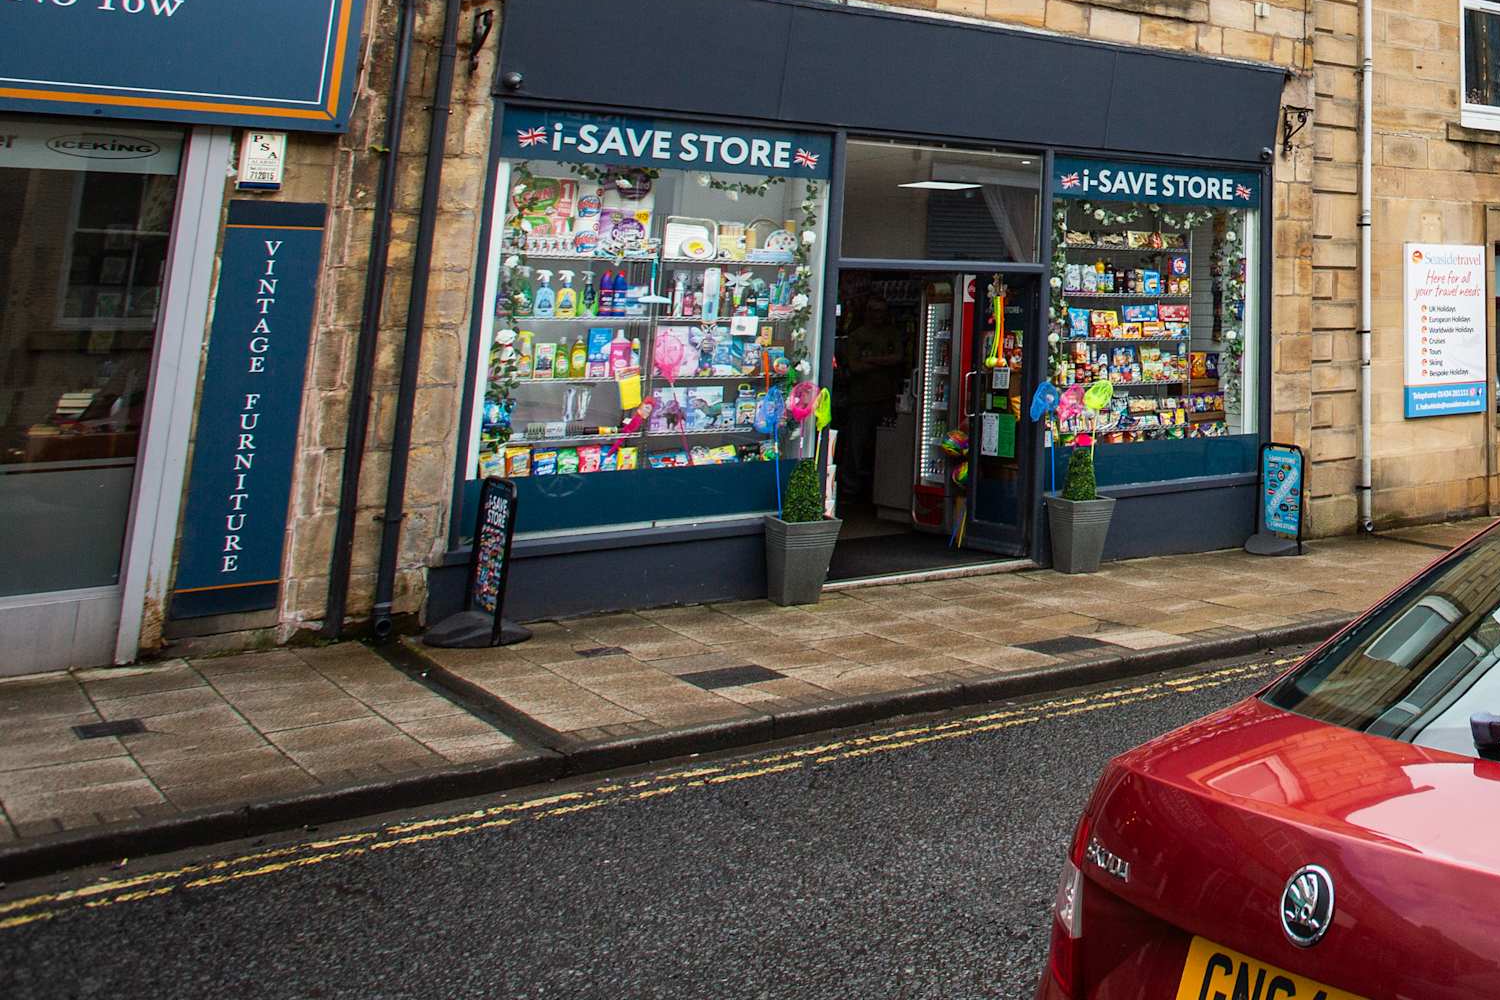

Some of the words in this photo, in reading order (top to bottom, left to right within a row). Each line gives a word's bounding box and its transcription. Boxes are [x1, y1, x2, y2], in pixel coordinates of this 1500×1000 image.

[552, 122, 672, 160] i-SAVE
[679, 132, 791, 169] STORE
[1082, 168, 1157, 196] i-SAVE
[1162, 174, 1233, 200] STORE
[1424, 251, 1482, 266] Seasidetravel
[1425, 269, 1446, 285] Here
[1448, 270, 1460, 285] for
[1414, 288, 1433, 301] your
[1435, 284, 1459, 298] travel
[1459, 287, 1481, 298] needs
[248, 239, 283, 374] VINTAGE
[1437, 305, 1457, 313] Holidays
[1452, 315, 1471, 325] Holidays
[1429, 327, 1455, 335] Worldwide
[1455, 326, 1475, 335] Holidays
[1429, 337, 1446, 345] Cruises
[1429, 369, 1449, 378] Bespoke
[1449, 368, 1470, 377] Holidays
[221, 393, 261, 574] FURNITURE
